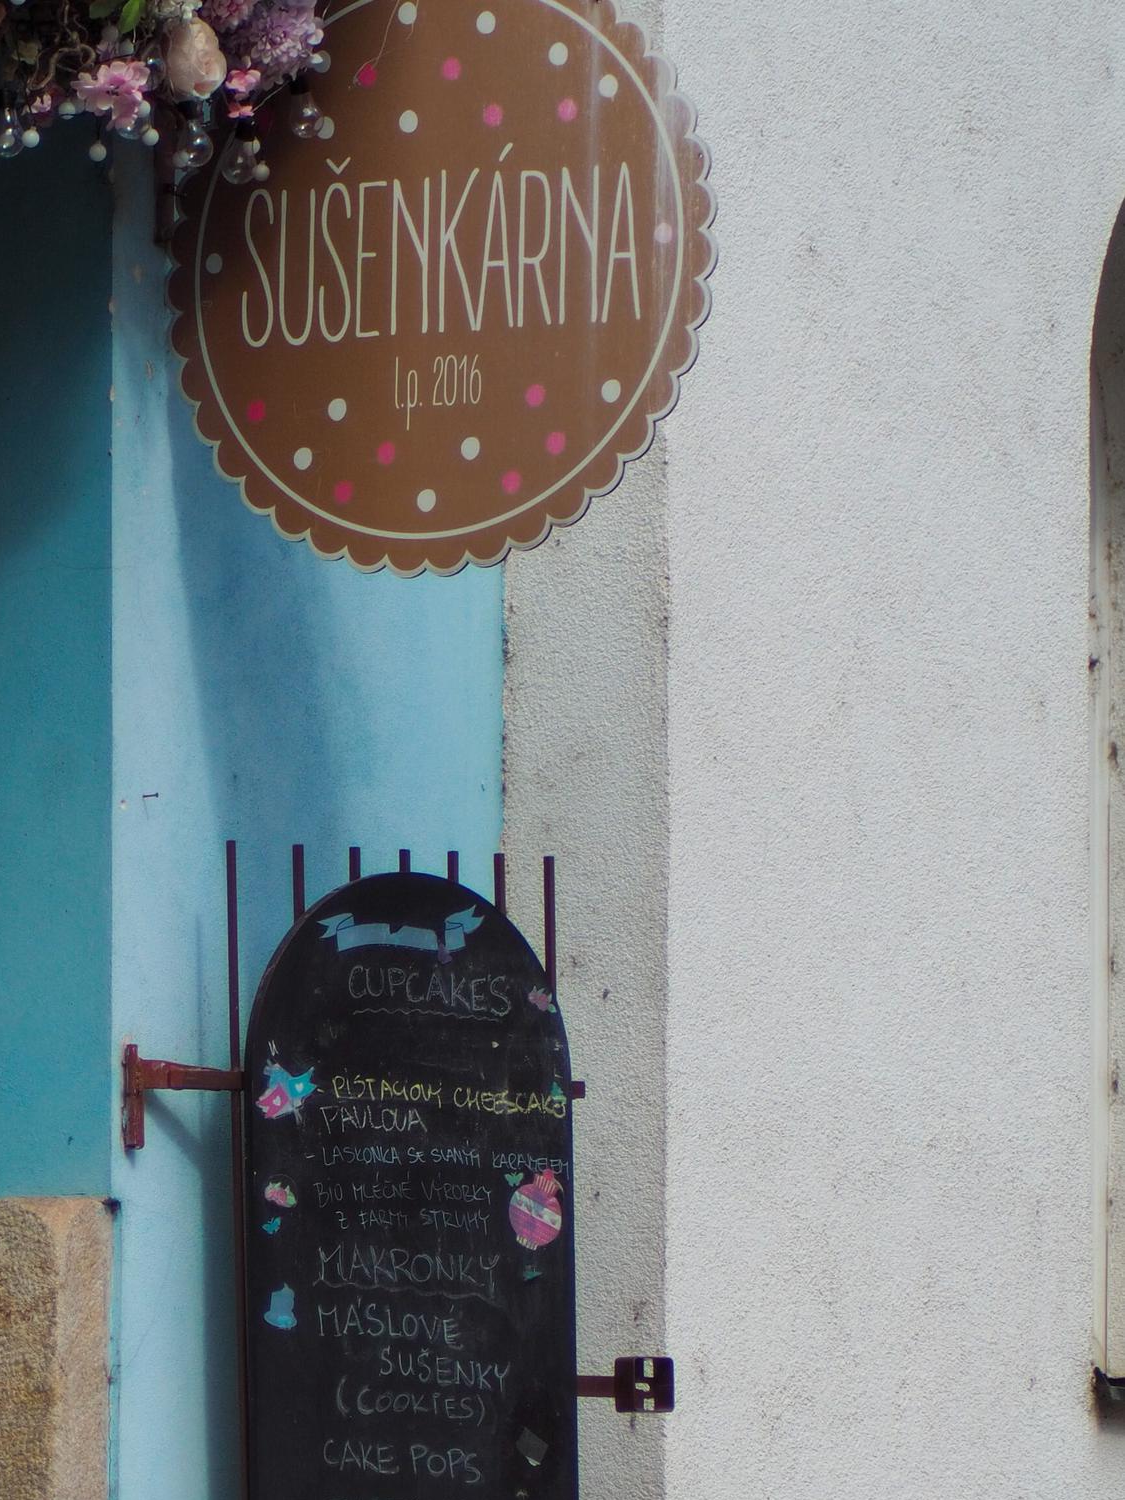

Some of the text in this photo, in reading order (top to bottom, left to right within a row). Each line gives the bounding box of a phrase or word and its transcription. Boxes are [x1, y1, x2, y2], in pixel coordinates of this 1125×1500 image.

[241, 143, 641, 349] SUŠENKÁRNA
[394, 355, 482, 430] l.p. 2016
[319, 1105, 428, 1134] PAVLOVA
[313, 1182, 343, 1208] BIO
[335, 1210, 349, 1229] Z
[318, 1242, 500, 1297] MAKRONKY
[317, 1296, 463, 1349] MÁSLOVÉ
[379, 1345, 511, 1392] SUŠENKY
[336, 1375, 485, 1427] (COOKIES)
[323, 1440, 482, 1484] CAKE POPS
